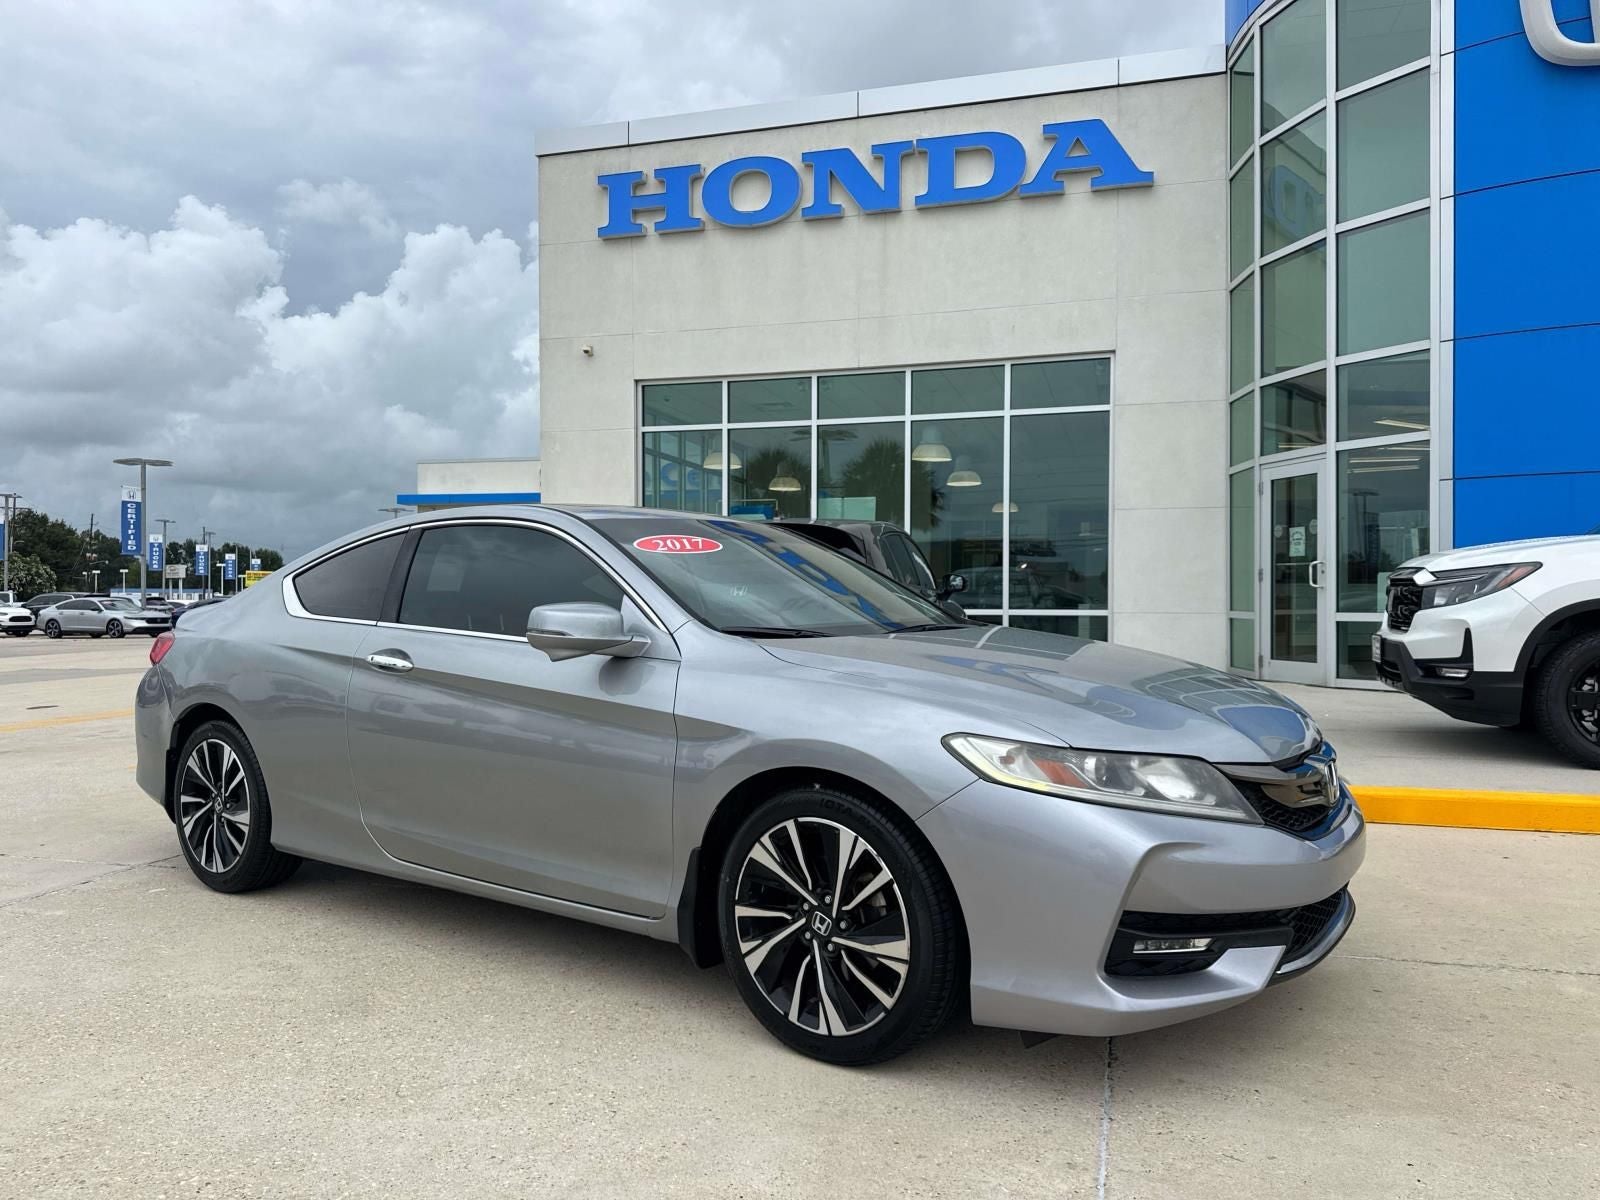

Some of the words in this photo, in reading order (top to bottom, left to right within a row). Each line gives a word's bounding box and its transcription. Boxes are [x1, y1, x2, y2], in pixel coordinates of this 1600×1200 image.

[598, 119, 1154, 240] HONDA
[127, 503, 136, 550] CERTIFIED
[651, 538, 703, 551] 2017
